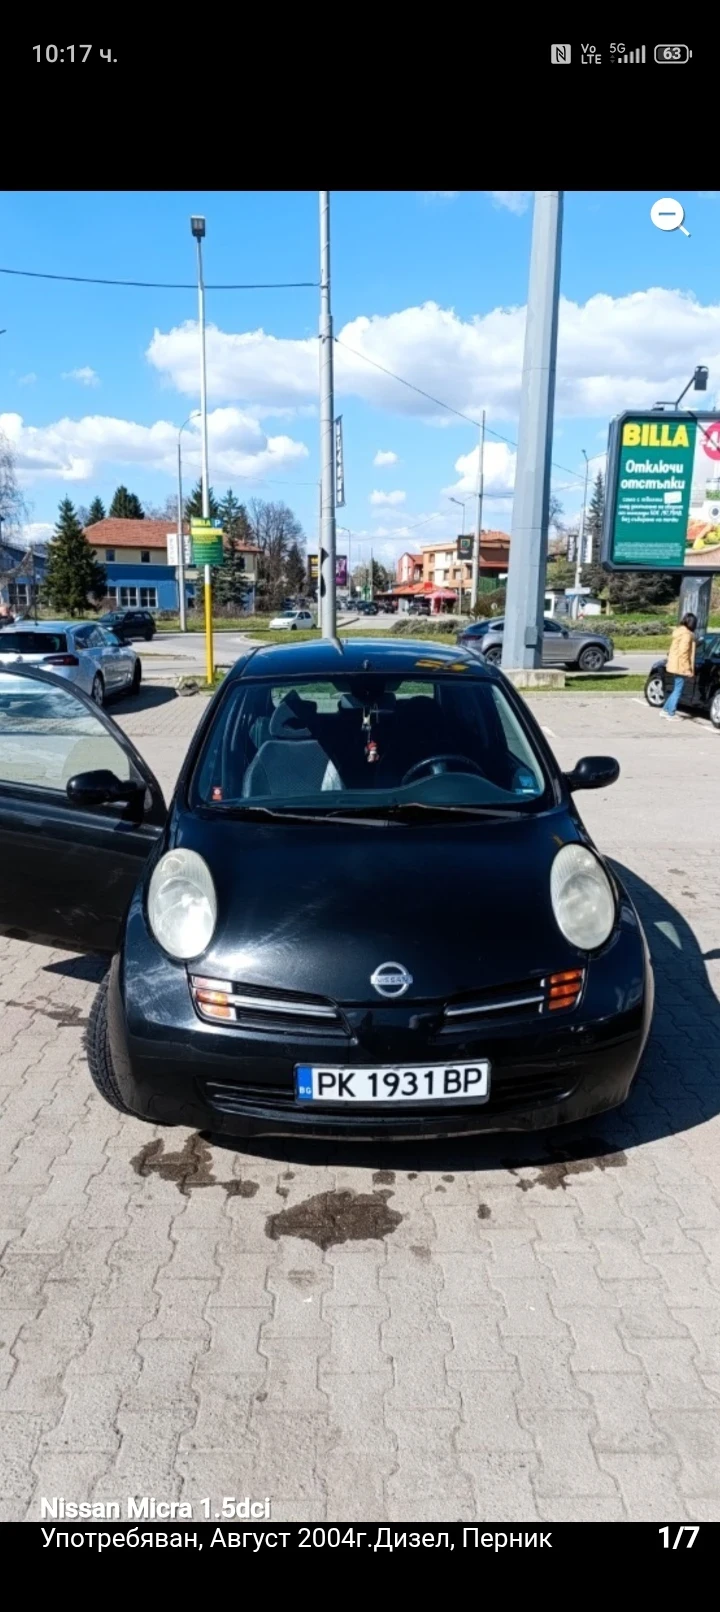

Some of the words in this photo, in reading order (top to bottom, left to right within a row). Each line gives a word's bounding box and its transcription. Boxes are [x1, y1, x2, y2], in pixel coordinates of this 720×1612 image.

[622, 422, 690, 447] BILLA
[625, 459, 684, 474] Отключи
[620, 476, 686, 490] отстъпки
[375, 976, 409, 984] NISSAN
[317, 1072, 357, 1097] PK
[367, 1070, 434, 1098] 1931
[443, 1067, 482, 1095] BP
[299, 1086, 312, 1095] BG
